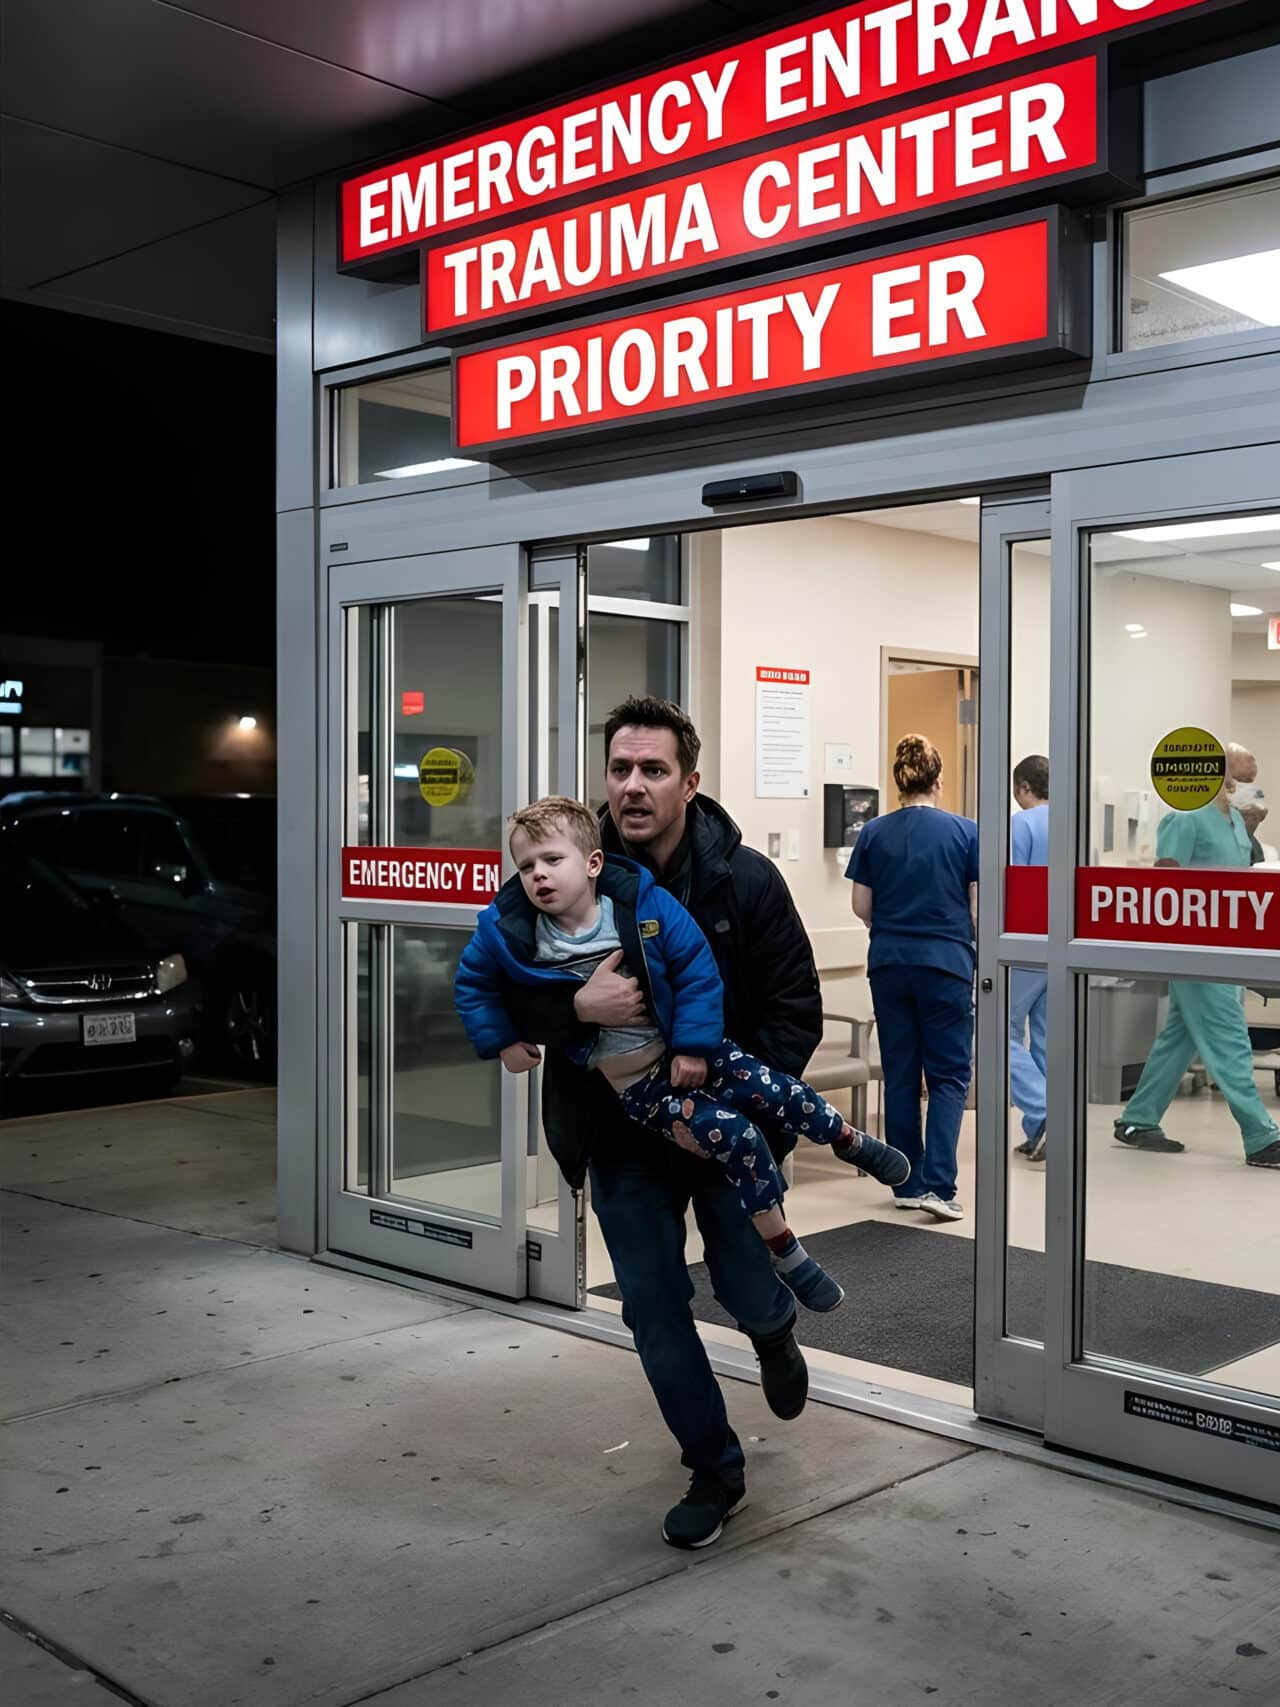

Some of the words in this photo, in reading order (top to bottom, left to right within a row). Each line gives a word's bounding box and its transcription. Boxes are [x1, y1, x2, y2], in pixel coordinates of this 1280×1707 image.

[360, 60, 739, 248] EMERGENCY
[444, 182, 719, 317] TRAUMA
[743, 82, 1067, 239] CENTER
[497, 283, 841, 430] PRIORITY
[872, 255, 986, 357] ER
[350, 859, 466, 891] EMERGENCY
[473, 864, 499, 892] EN
[1091, 885, 1274, 930] PRIORITY
